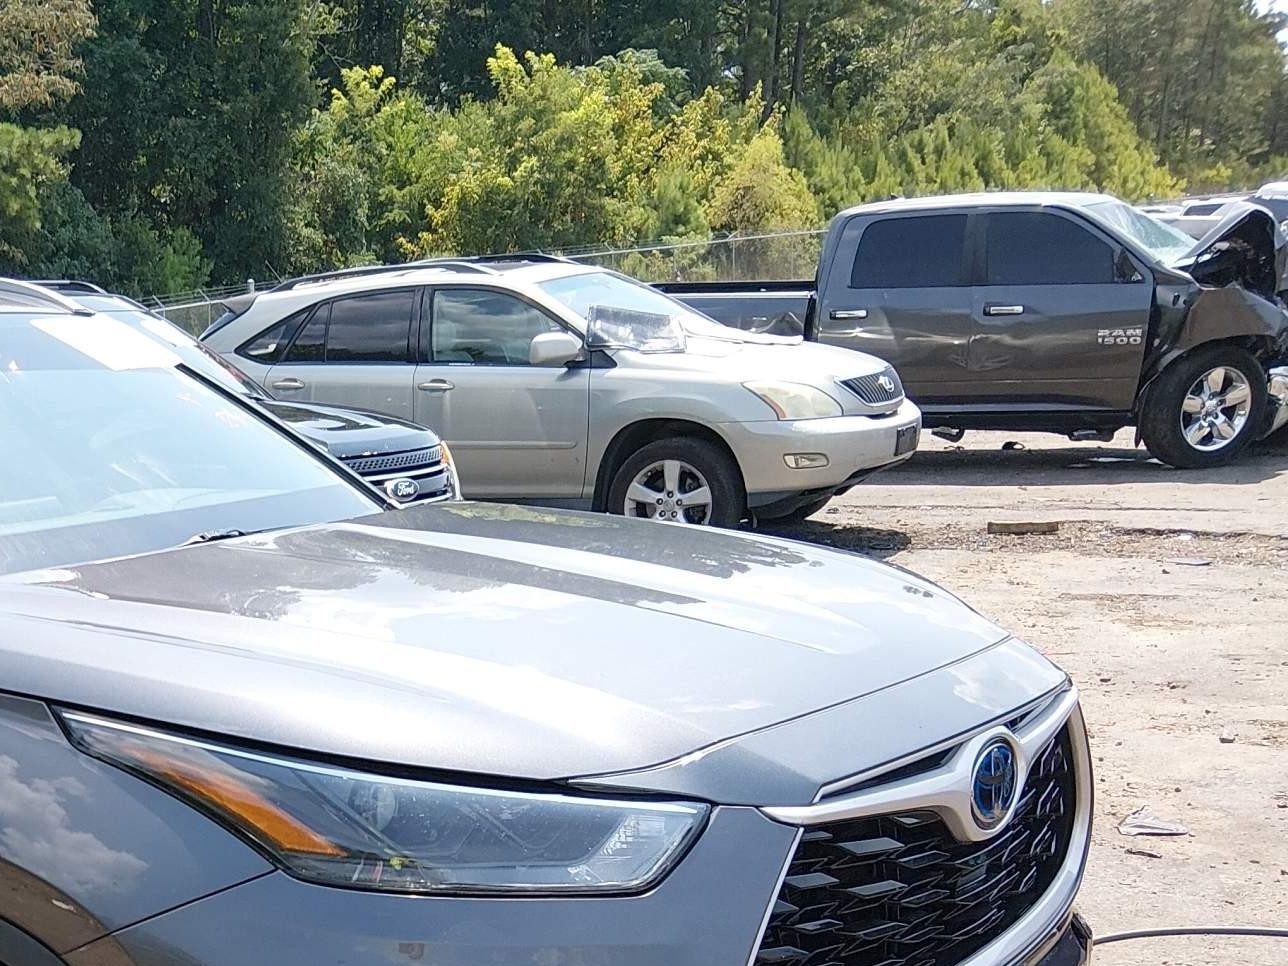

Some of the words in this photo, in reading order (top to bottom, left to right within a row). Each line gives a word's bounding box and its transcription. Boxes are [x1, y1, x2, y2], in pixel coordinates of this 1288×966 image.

[1097, 328, 1143, 337] RAM
[1097, 336, 1142, 345] 1500
[397, 481, 415, 496] Ford
